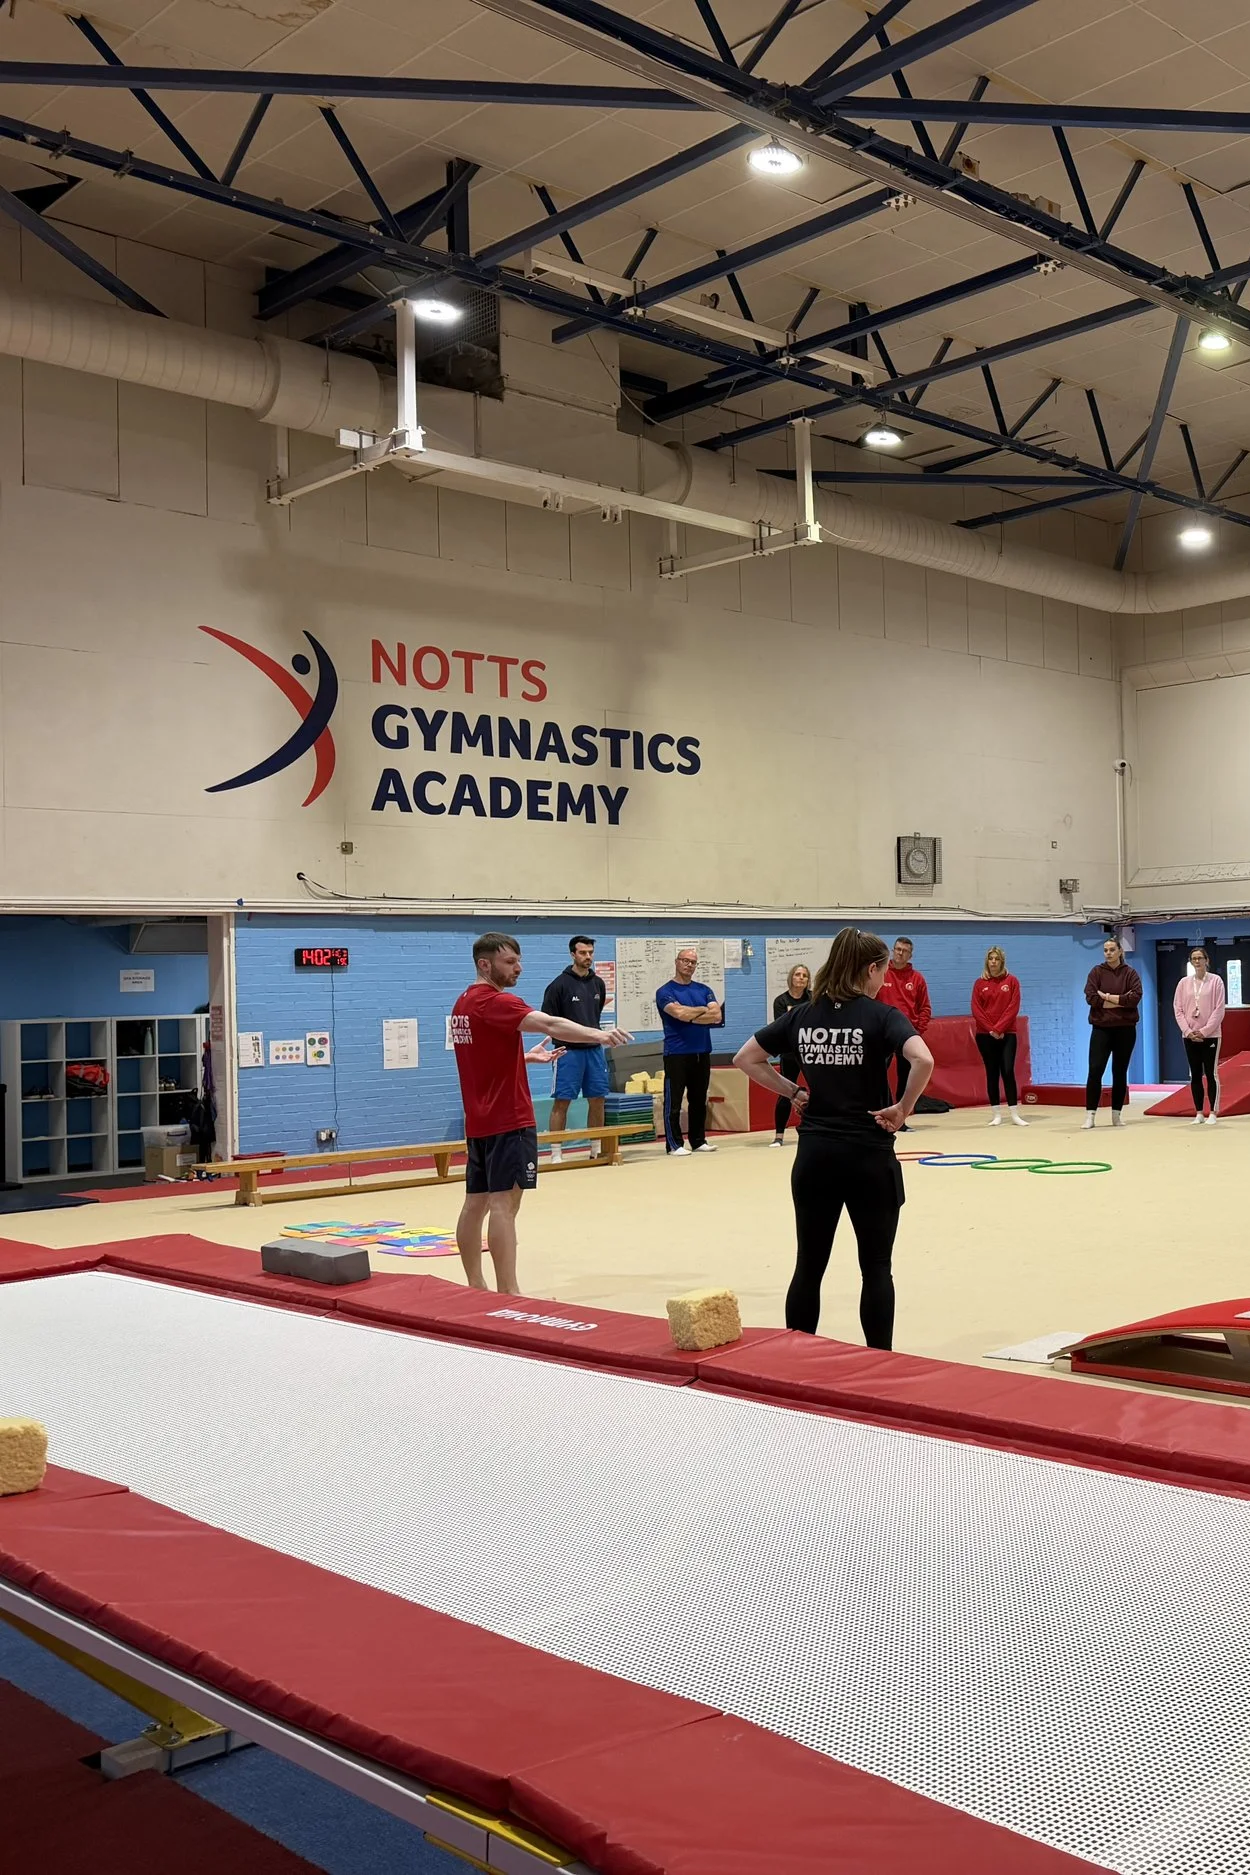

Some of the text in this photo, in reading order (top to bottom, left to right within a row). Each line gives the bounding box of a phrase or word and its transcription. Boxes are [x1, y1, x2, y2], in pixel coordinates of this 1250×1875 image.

[371, 638, 548, 703] NOTTS
[371, 704, 701, 775] GYMNASTICS
[371, 768, 629, 825] ACADEMY
[451, 1015, 470, 1028] OTTS
[798, 1027, 864, 1045] NOTTS
[798, 1044, 864, 1054] GYMNASTICS
